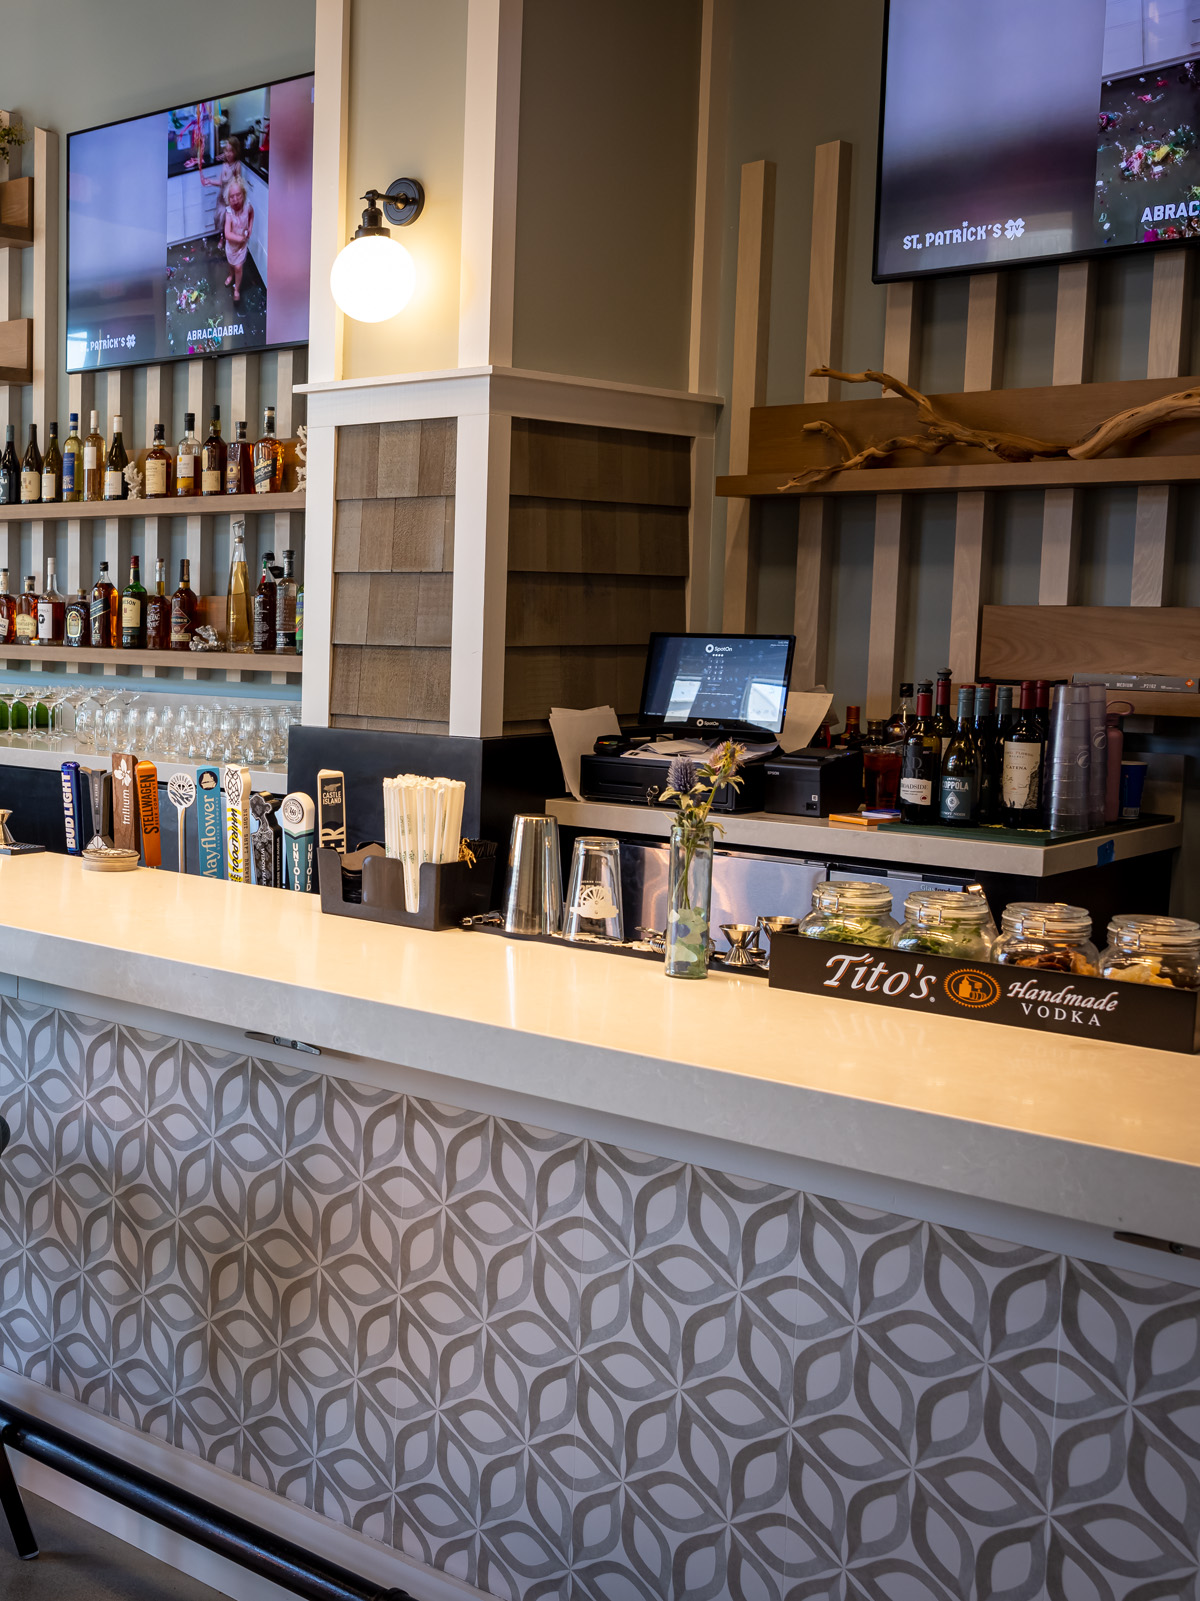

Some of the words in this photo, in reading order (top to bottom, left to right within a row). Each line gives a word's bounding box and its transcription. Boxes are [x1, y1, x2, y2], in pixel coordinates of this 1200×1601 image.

[903, 234, 923, 250] ST.
[186, 323, 245, 341] ABRACADABRA
[61, 772, 74, 816] LIGHT
[122, 789, 131, 825] trillium
[140, 774, 160, 835] STELLWAGEN
[322, 791, 342, 799] CASTLE
[64, 817, 76, 849] BUD
[230, 808, 240, 872] WHIRLPOOL
[292, 842, 301, 892] UNTOLD
[305, 843, 313, 892] UNTOLD
[822, 953, 937, 999] Tito's
[1007, 979, 1119, 1012] Handmade
[1020, 1002, 1102, 1027] VODKA
